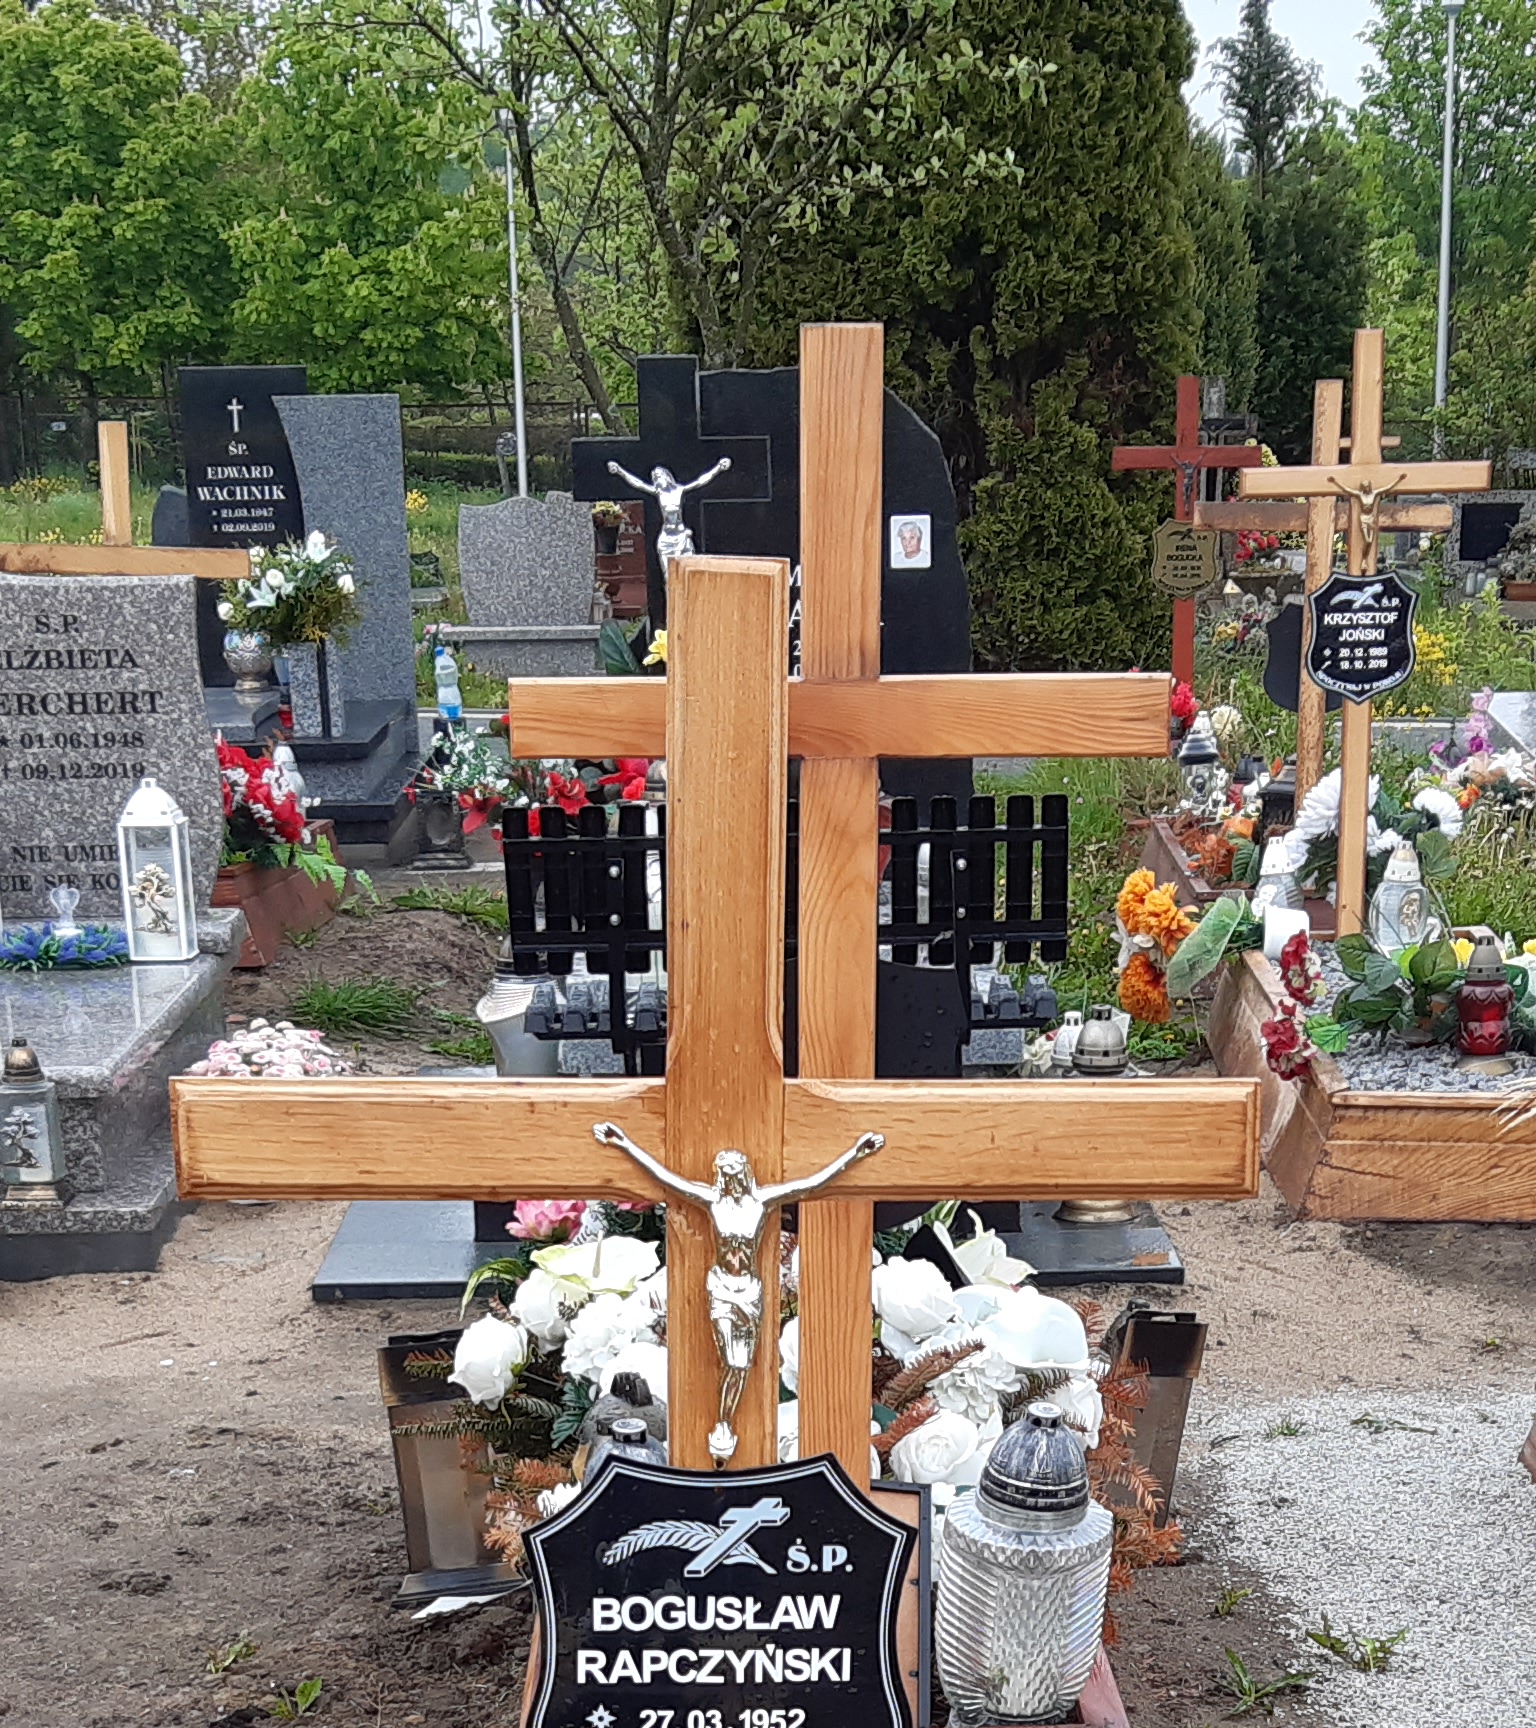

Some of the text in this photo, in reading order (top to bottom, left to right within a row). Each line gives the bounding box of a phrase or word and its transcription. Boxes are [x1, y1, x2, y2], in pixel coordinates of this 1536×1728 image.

[206, 465, 274, 479] EDWARD
[1324, 611, 1399, 626] KRZYSZTOF
[1339, 626, 1385, 642] JOŃSKI
[13, 843, 120, 864] NIE UMIE
[90, 872, 121, 891] KO
[786, 1539, 854, 1573] Ś.P.
[592, 1595, 841, 1632] BOGUSŁAW
[576, 1642, 852, 1684] RAPCZYŃSKI
